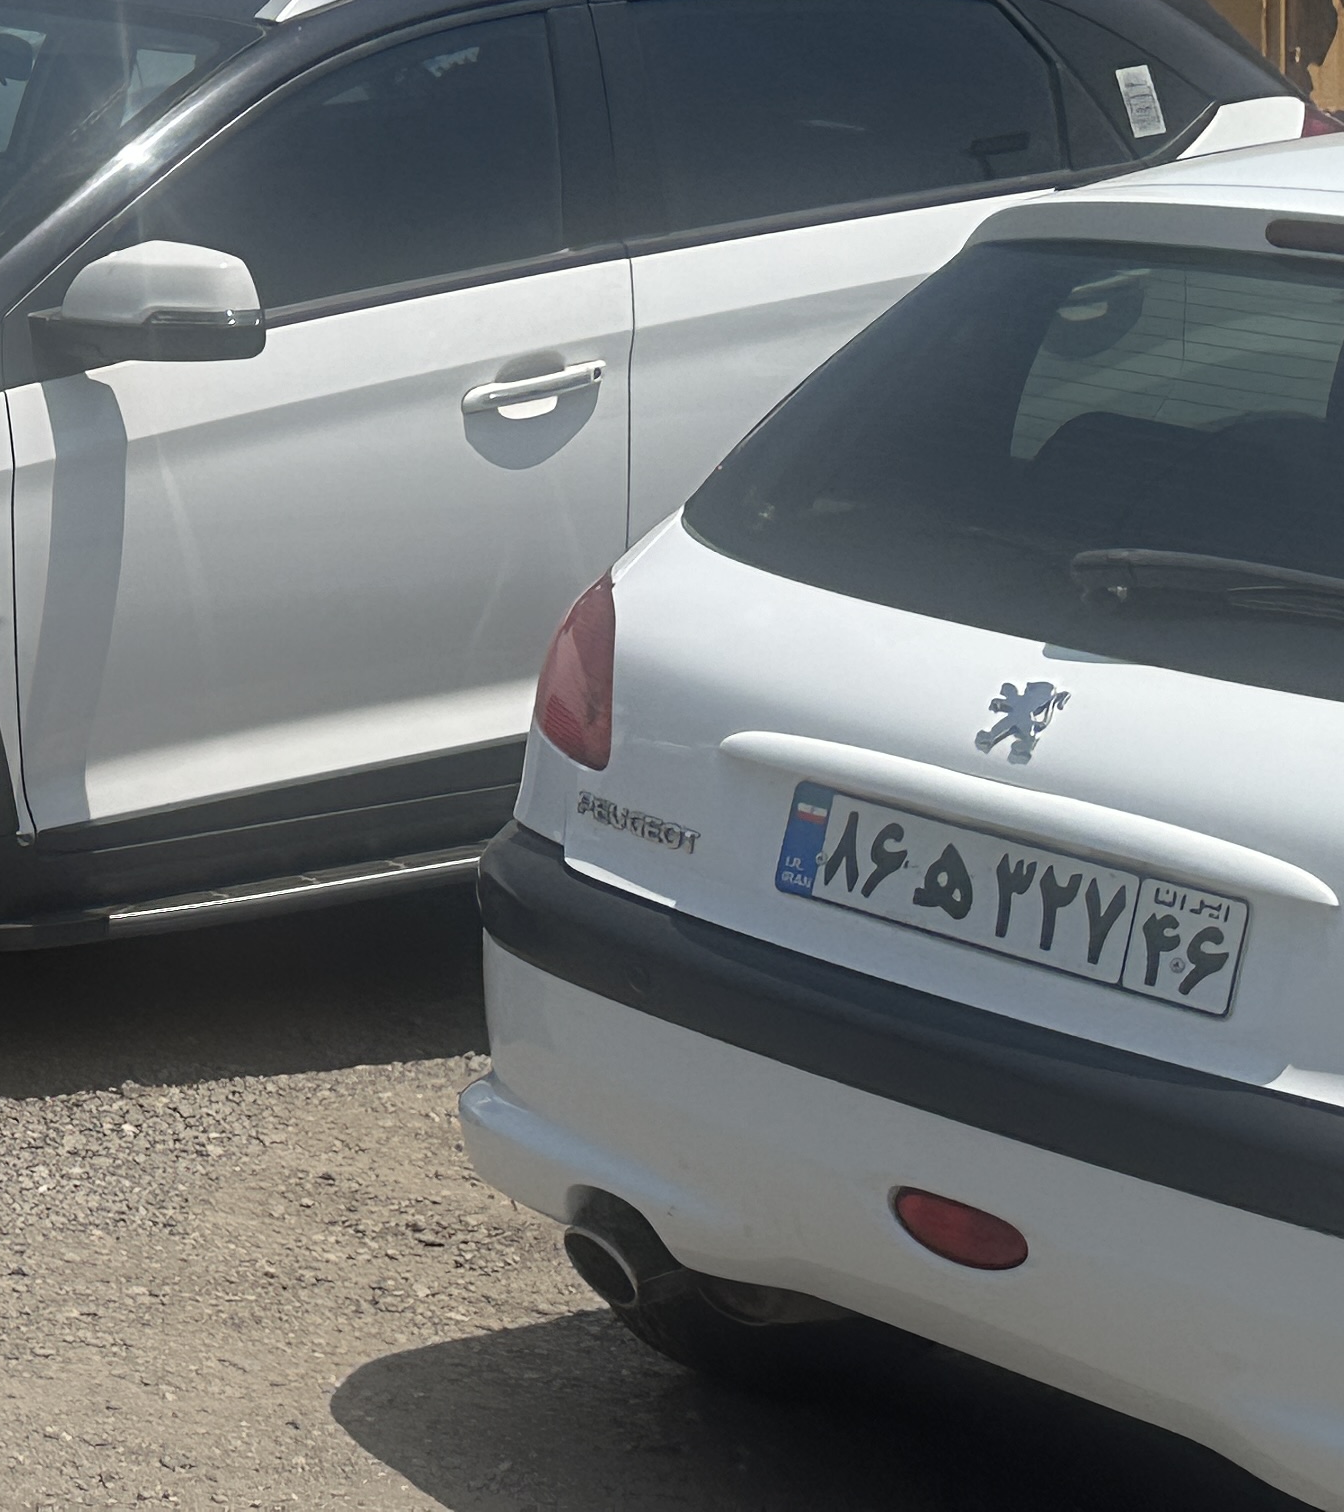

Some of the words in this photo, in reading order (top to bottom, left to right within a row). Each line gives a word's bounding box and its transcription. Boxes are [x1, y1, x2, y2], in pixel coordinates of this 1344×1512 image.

[576, 790, 702, 855] PEUGEOT
[823, 810, 909, 899] ۸۶
[994, 852, 1127, 965] ۳۲۷
[1142, 912, 1230, 996] ۴۶
[1154, 886, 1231, 922] ایران
